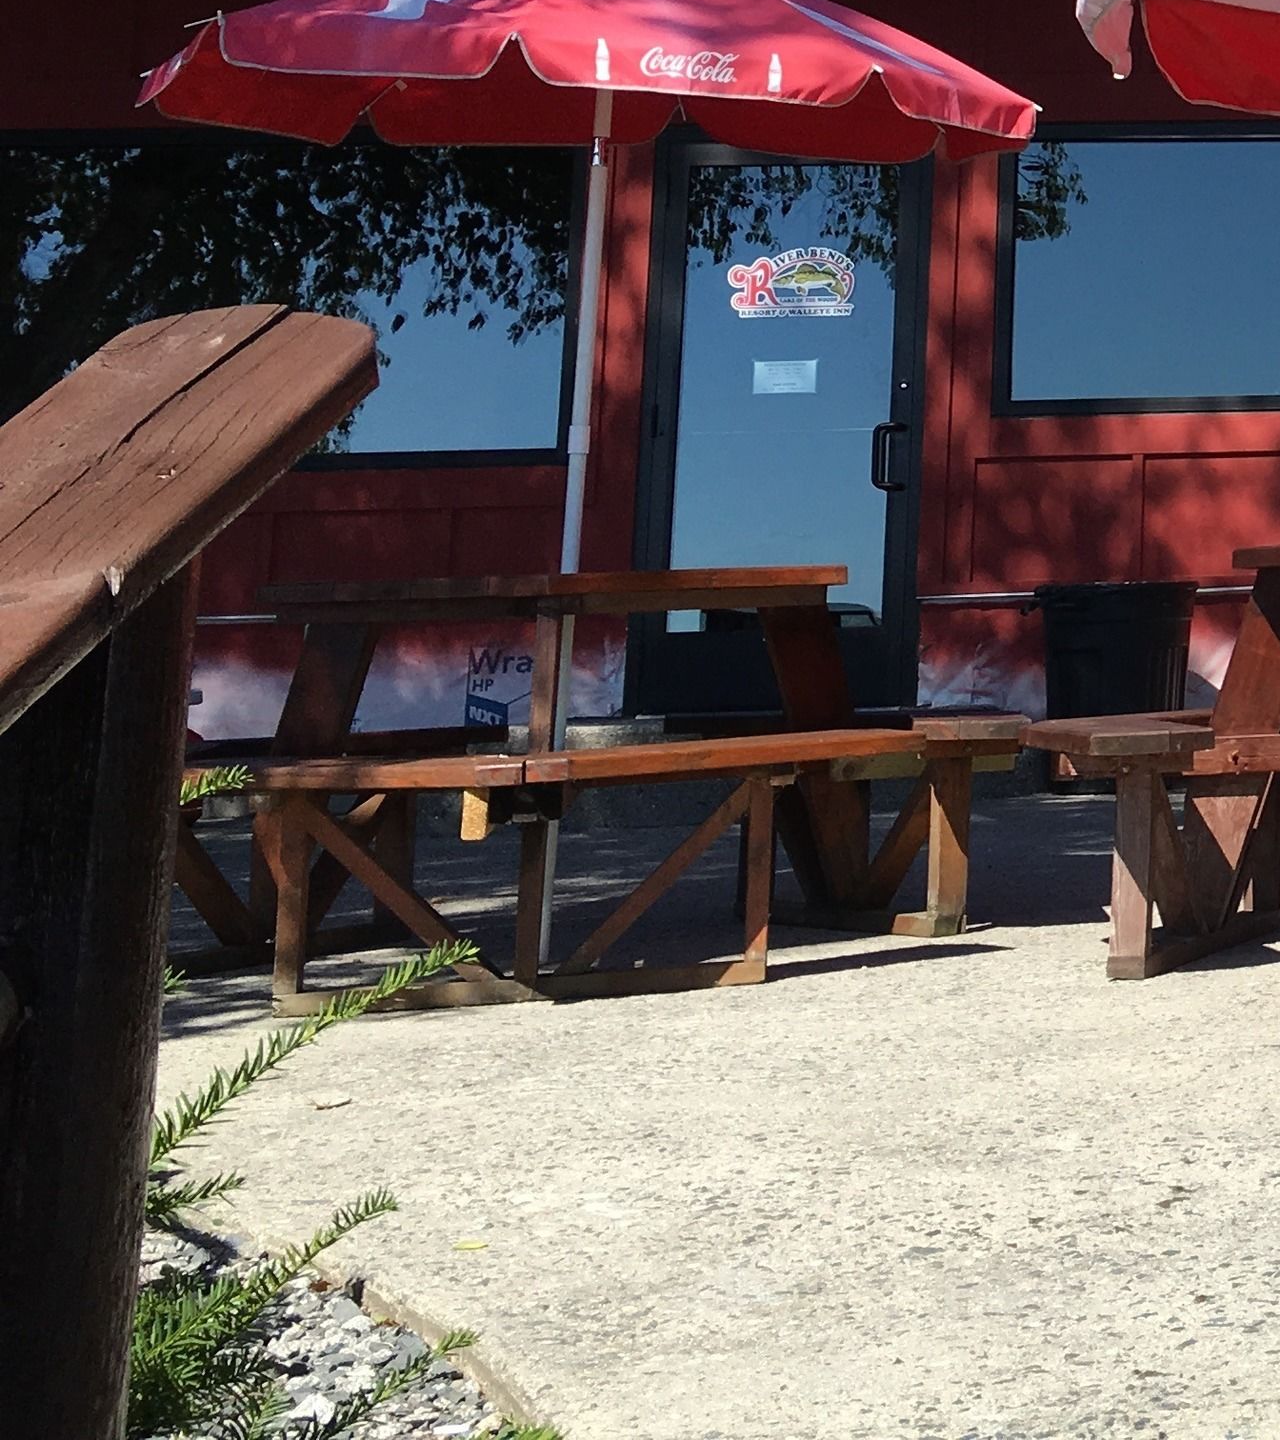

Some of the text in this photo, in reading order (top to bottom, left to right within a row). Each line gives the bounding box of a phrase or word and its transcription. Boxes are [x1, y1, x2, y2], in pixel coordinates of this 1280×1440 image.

[469, 648, 533, 675] Wra
[471, 678, 495, 692] HP
[468, 705, 504, 725] NXT
